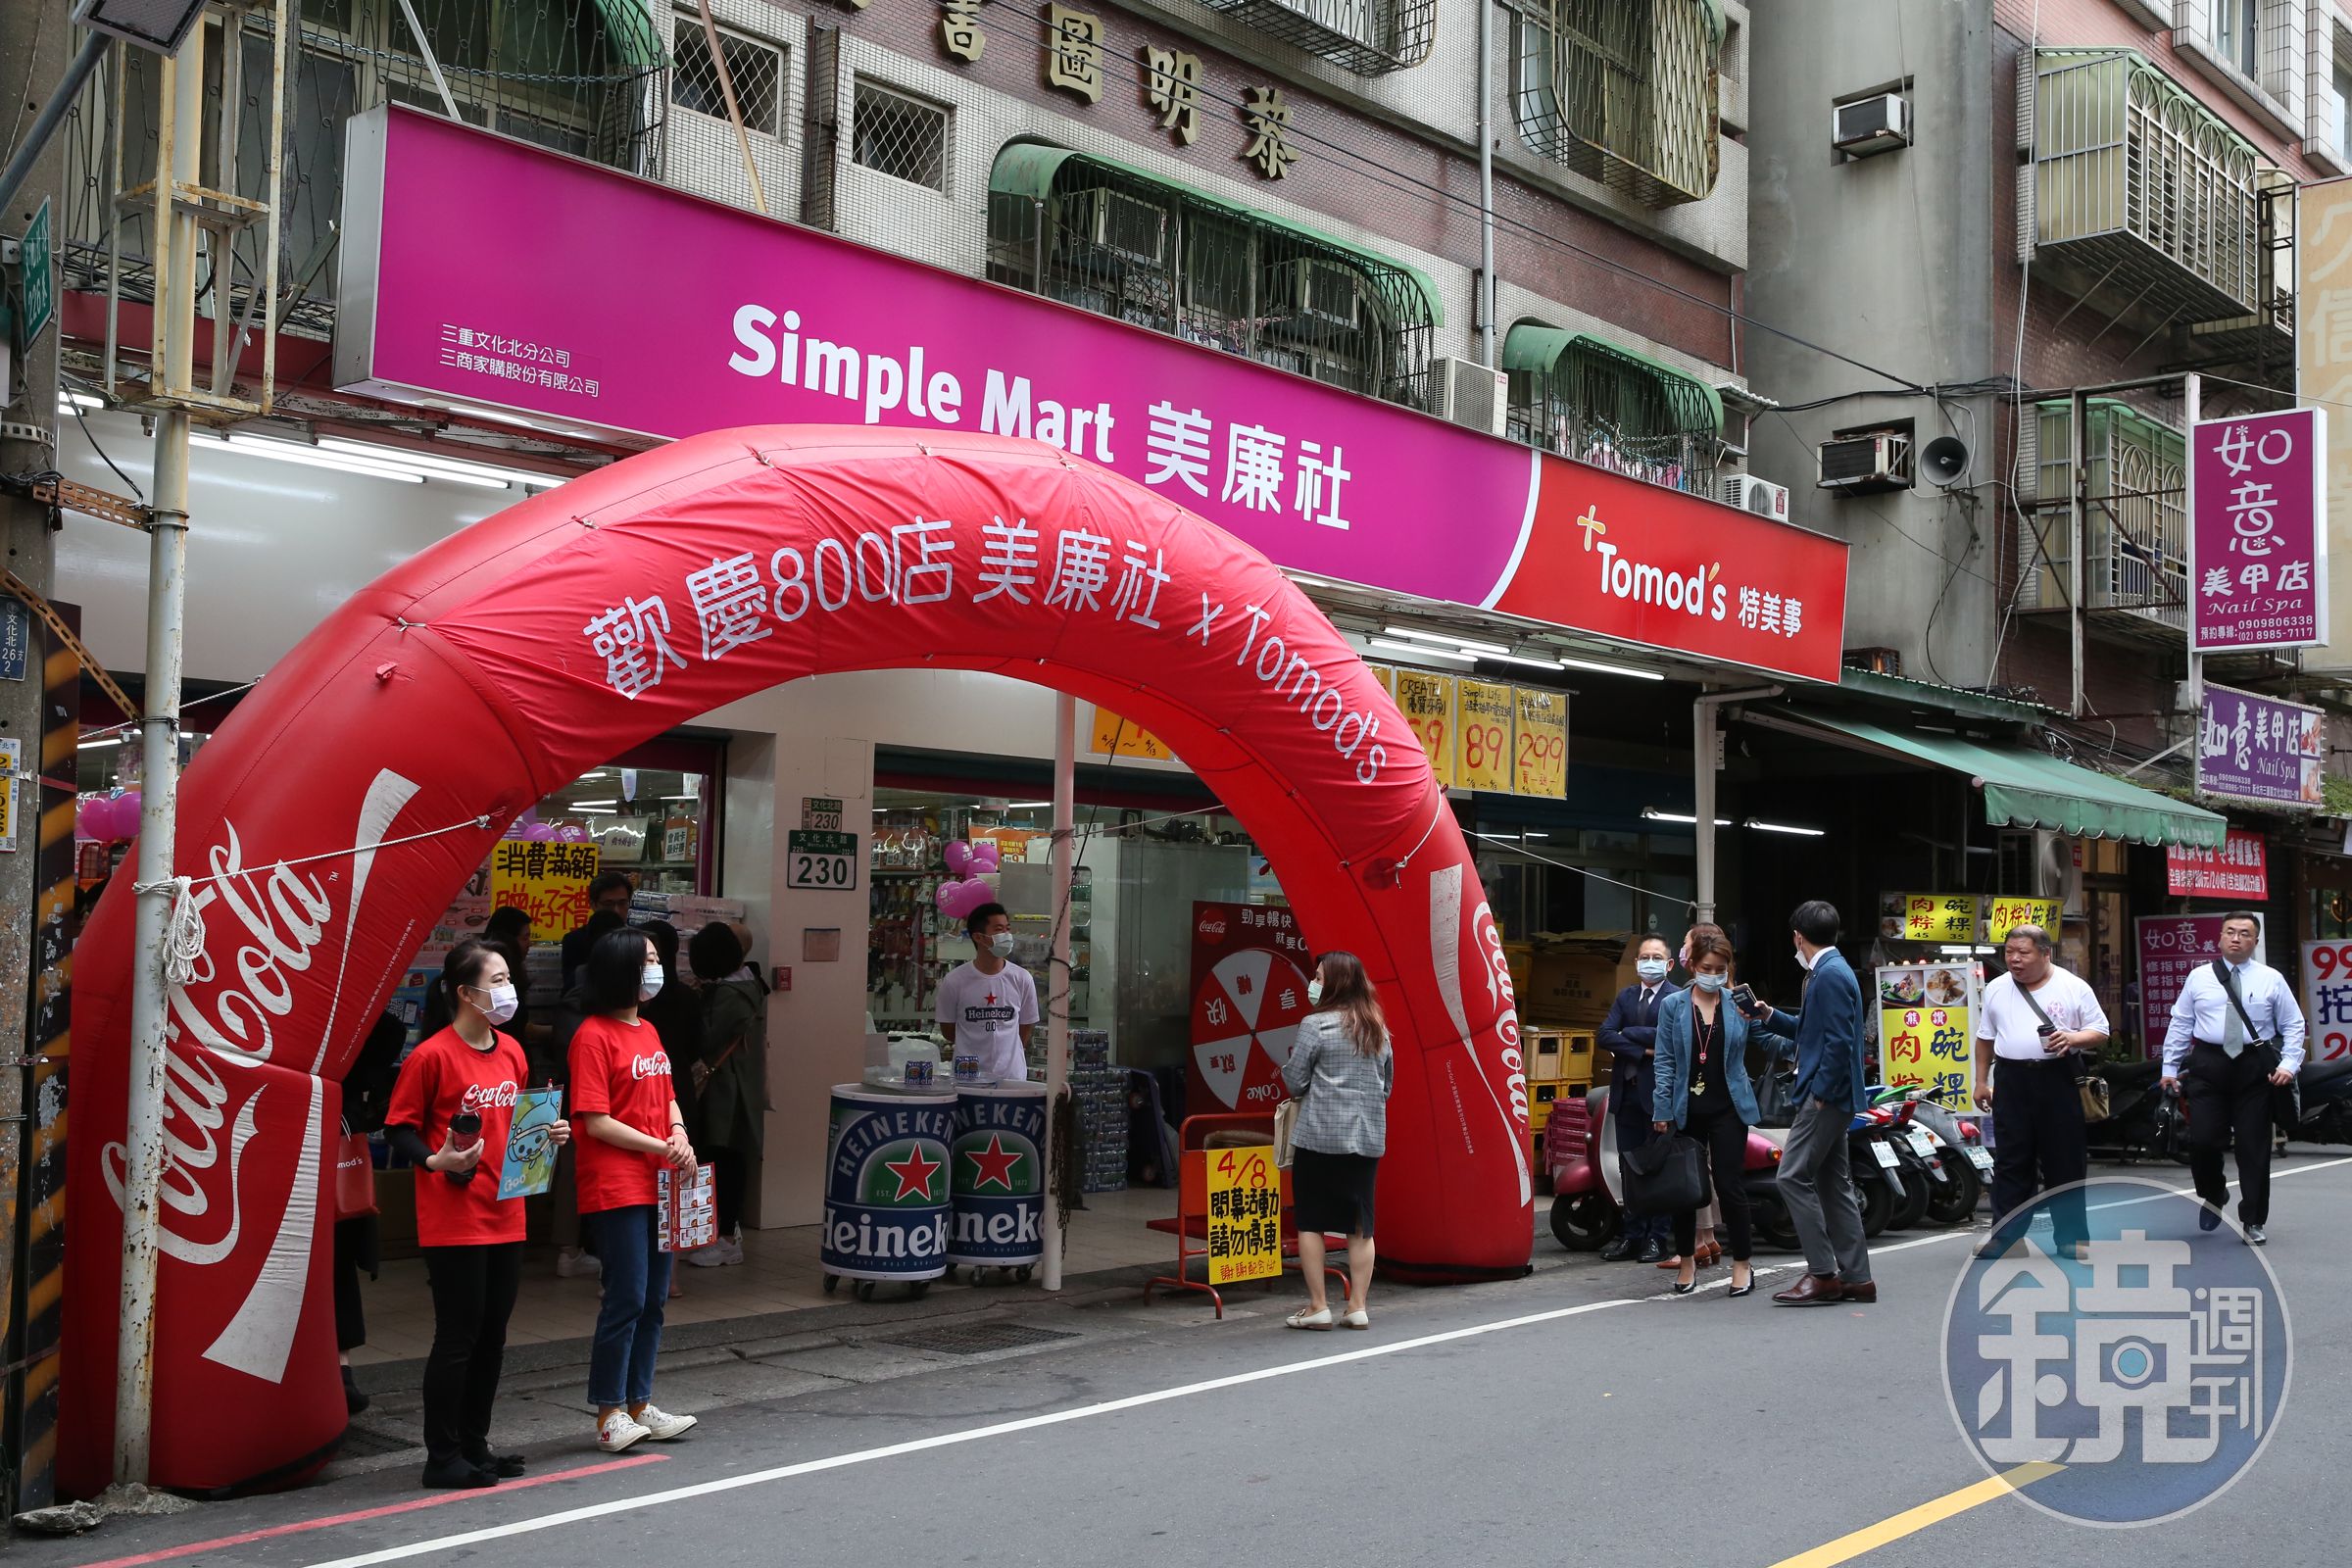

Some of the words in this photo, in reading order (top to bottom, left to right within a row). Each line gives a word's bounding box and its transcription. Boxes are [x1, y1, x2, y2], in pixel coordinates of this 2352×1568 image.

[441, 323, 570, 368] 三重文化北分公司
[439, 347, 600, 398] 三商家購股份有限公司
[728, 304, 962, 424] Simple
[980, 368, 1115, 464] Mart
[1145, 400, 1352, 531] 美廉社
[2213, 425, 2292, 557] 如意
[1596, 541, 1727, 621] Tomod's
[1739, 586, 1803, 640] 特美事
[2200, 561, 2311, 597] 美甲店
[2206, 598, 2260, 615] Nail
[2264, 597, 2304, 616] Spa
[2238, 615, 2314, 629] 0909806338
[5, 613, 18, 647] 文化北
[2200, 626, 2238, 642] 預約專線:
[2238, 630, 2254, 642] (02)
[2256, 627, 2314, 641] 8985-7117
[583, 514, 956, 701] 歡慶800店
[972, 514, 1171, 629] 美廉社
[1237, 604, 1387, 785] Tomod's
[1407, 696, 1446, 716] 優質牙刷
[1145, 739, 1157, 757] 4/13
[1466, 723, 1503, 771] 89
[1519, 732, 1564, 774] 299
[2257, 757, 2280, 776] Nail
[2280, 760, 2296, 785] Spa
[813, 813, 840, 830] 230
[799, 832, 848, 845] 文化北路
[497, 841, 597, 881] 消費滿額
[797, 856, 848, 885] 230
[494, 883, 591, 930] 贈好禮
[1241, 907, 1293, 929] 勁享暢快
[1909, 897, 1936, 930] 肉粽
[1944, 899, 1973, 931] 碗粿
[1993, 904, 2025, 928] 肉粽
[2031, 905, 2058, 929] 碗粿
[1199, 919, 1227, 935] Coca-Cola
[966, 1007, 1014, 1021] Heineken
[1246, 1082, 1282, 1102] Coke
[838, 1110, 955, 1177] HEINEKEN
[337, 1155, 364, 1169] mod's
[1216, 1150, 1267, 1188] 4/8
[1210, 1186, 1280, 1223] 開幕活動
[821, 1205, 949, 1258] Heinek
[1209, 1218, 1277, 1259] 請勿停車
[1220, 1258, 1265, 1281] 謝謝配合
